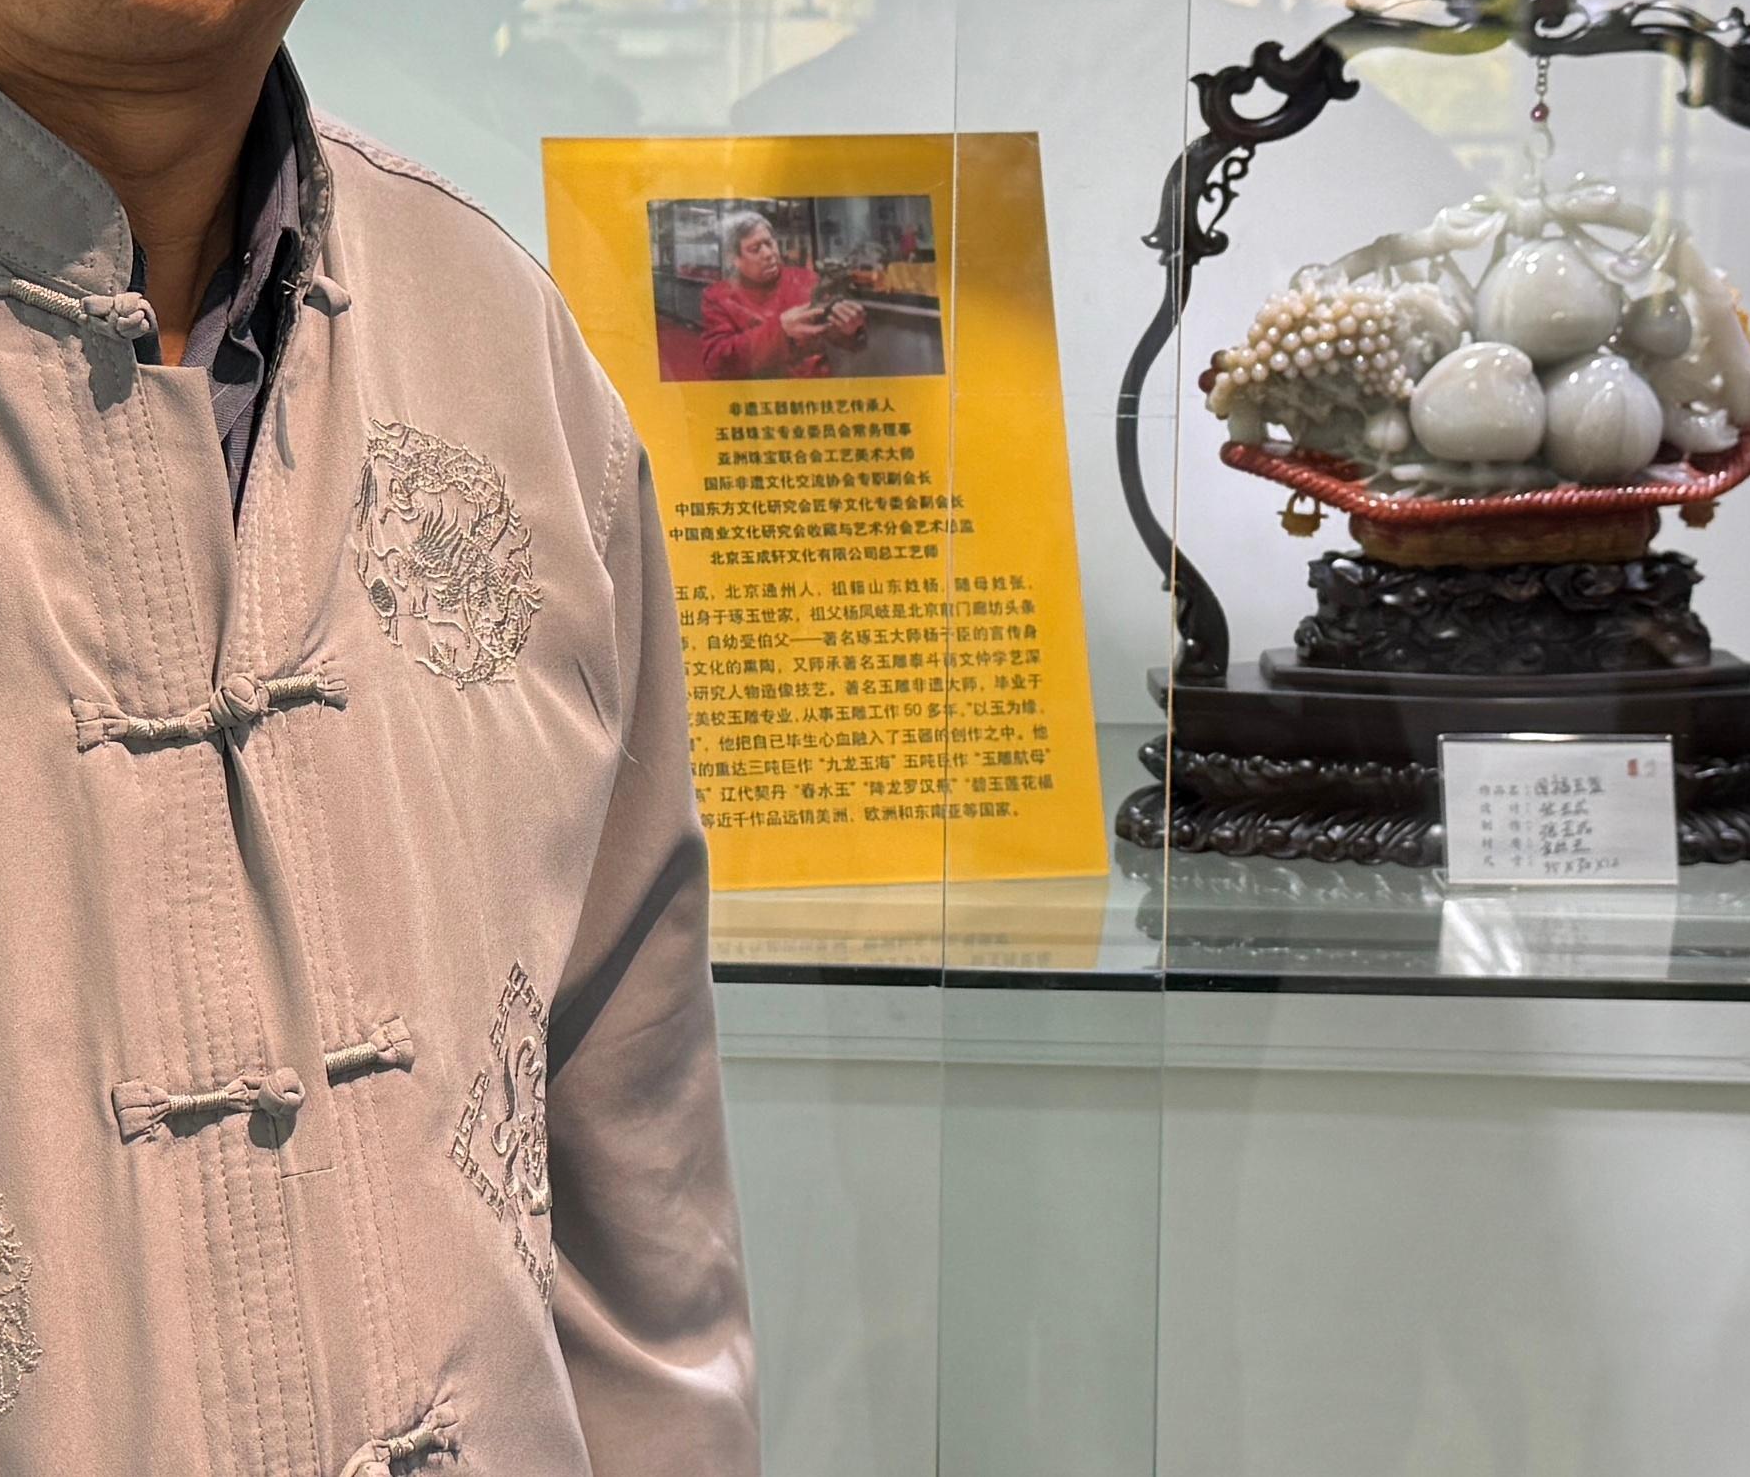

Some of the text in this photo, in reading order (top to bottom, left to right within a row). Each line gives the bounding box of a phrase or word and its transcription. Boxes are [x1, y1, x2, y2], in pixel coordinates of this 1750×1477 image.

[717, 446, 915, 466] 亚洲珠宝联合会工艺美术大师
